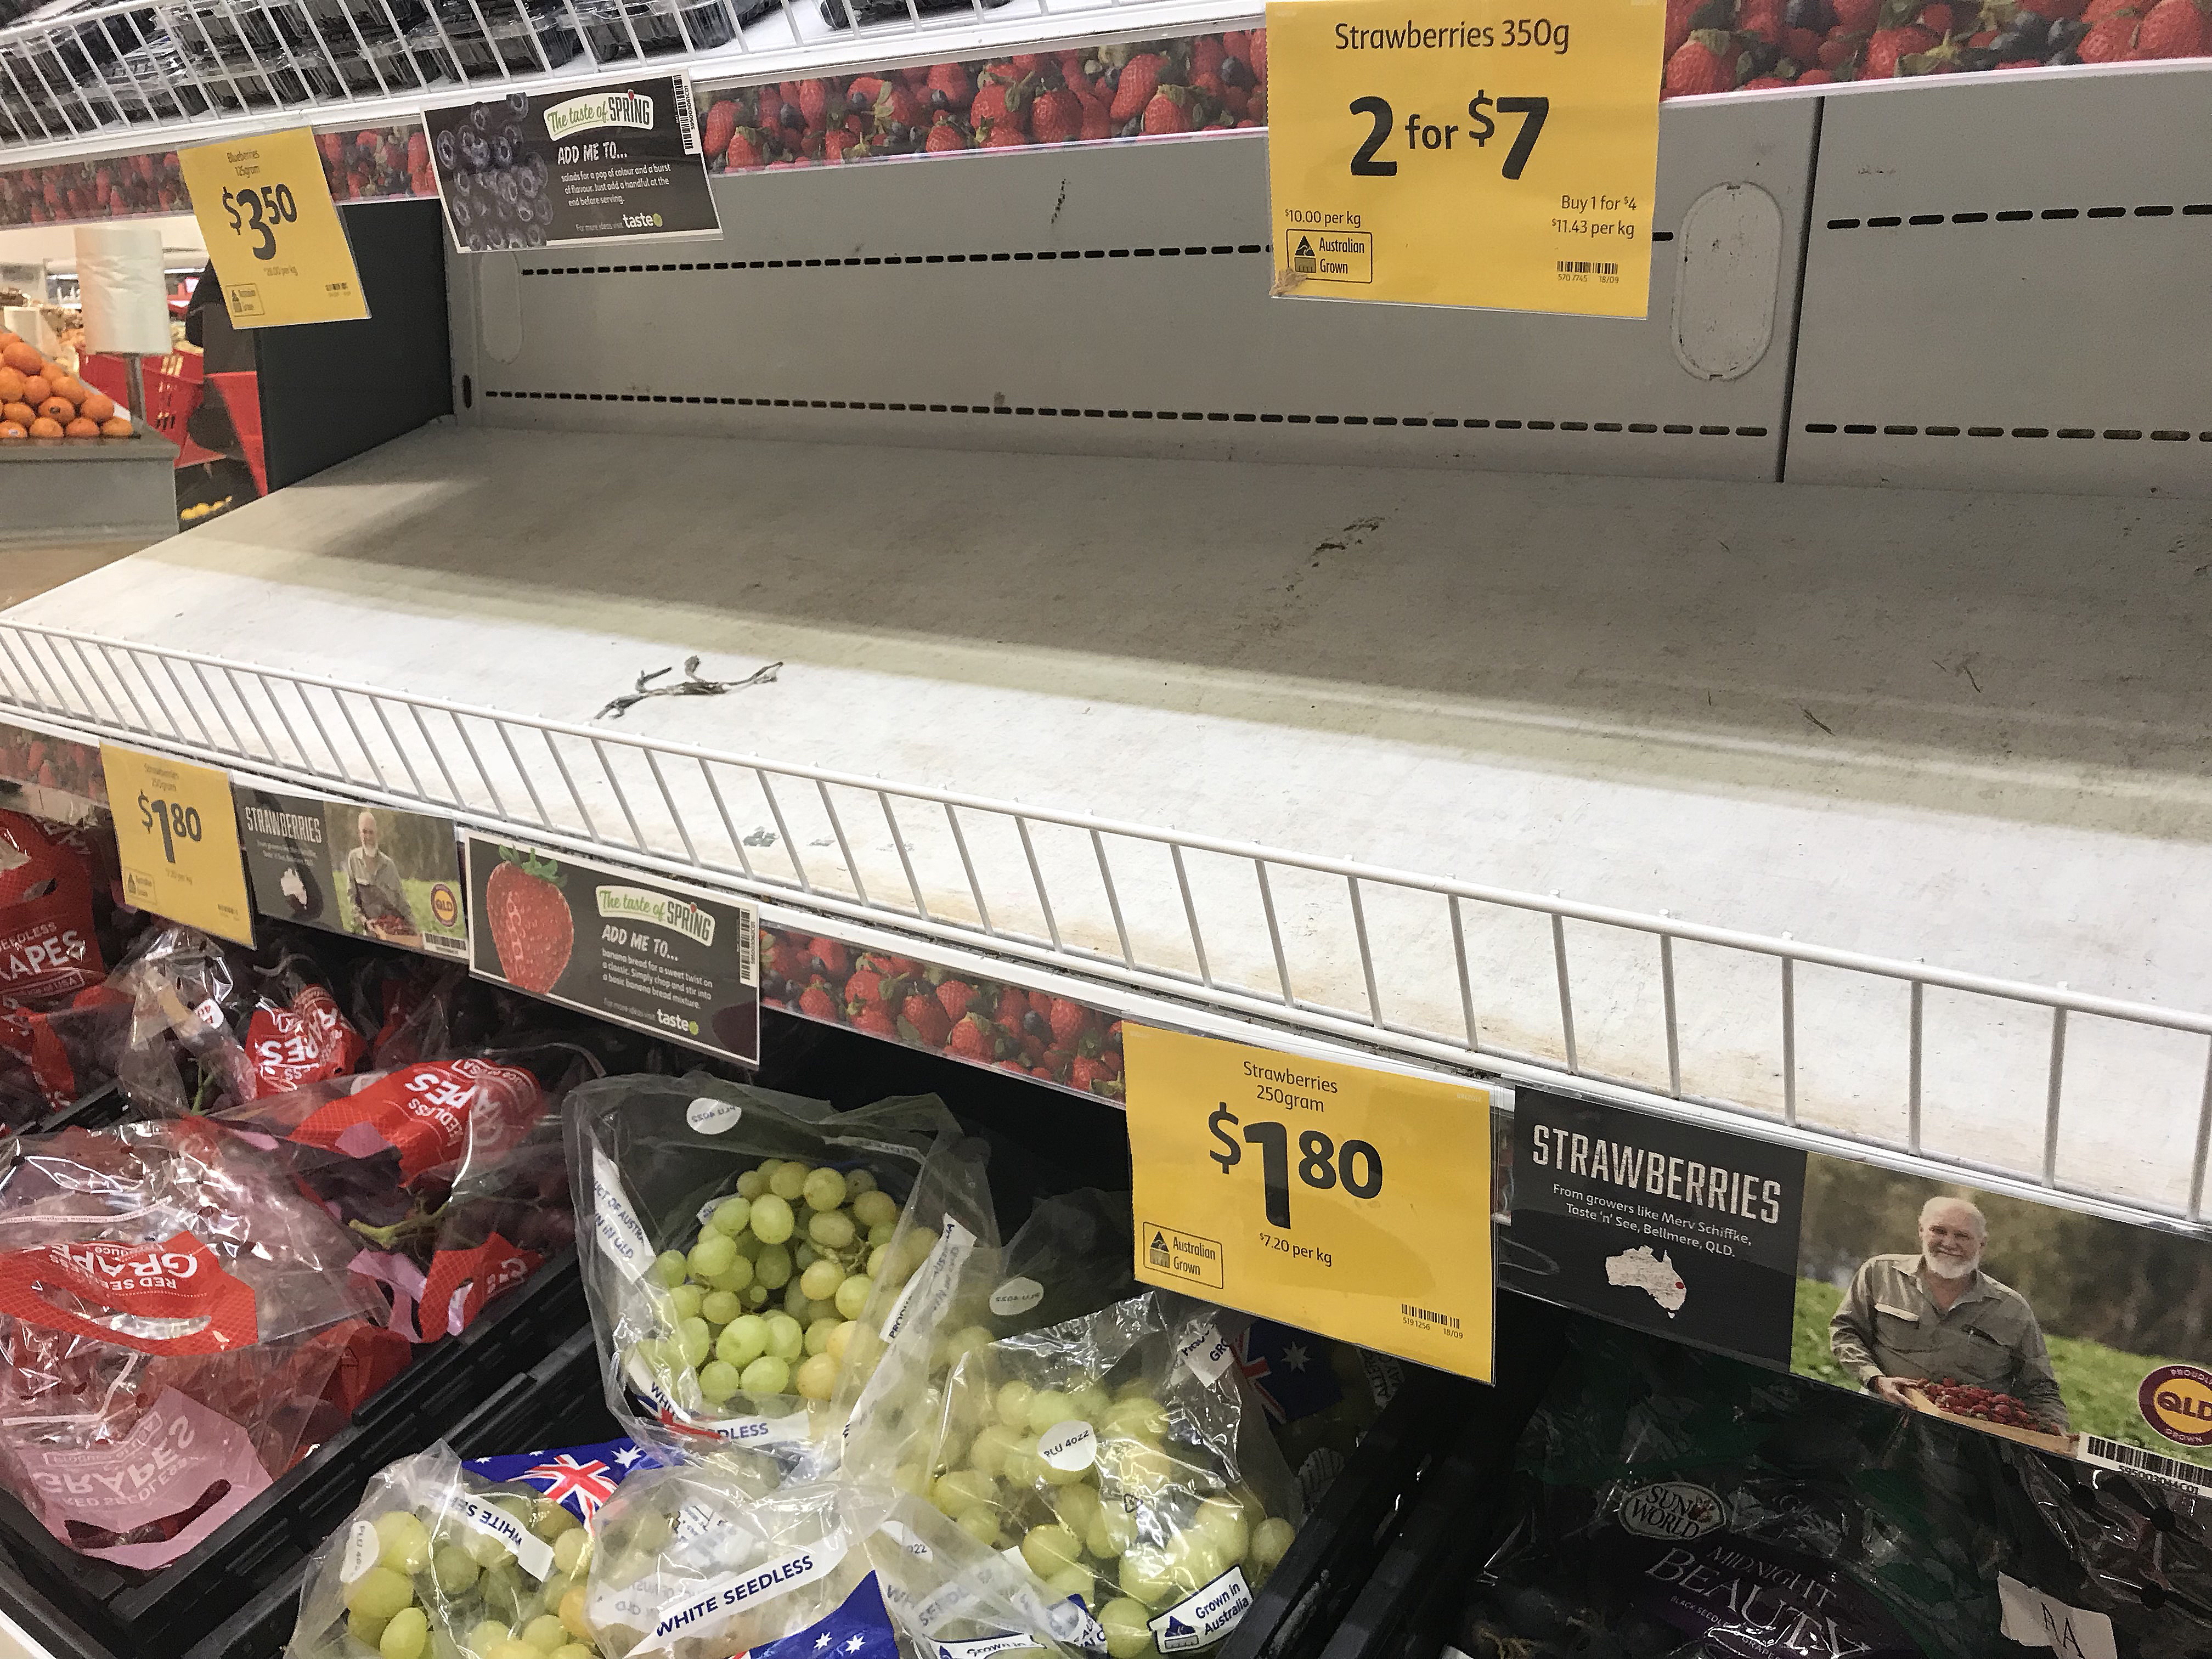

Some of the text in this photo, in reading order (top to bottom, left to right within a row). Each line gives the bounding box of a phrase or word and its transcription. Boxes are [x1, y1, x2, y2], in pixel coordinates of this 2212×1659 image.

[1335, 18, 1570, 55] Strawberries 350g
[548, 110, 567, 133] The
[569, 104, 595, 123] taste
[596, 101, 607, 123] of
[608, 94, 650, 125] SPRING
[1349, 89, 1550, 180] 2 for $7
[558, 141, 627, 165] ADD ME TO...
[561, 172, 580, 182] salads
[580, 171, 589, 180] for
[596, 171, 607, 181] pop
[608, 168, 614, 178] of
[615, 167, 634, 177] colour
[635, 165, 647, 174] and
[653, 163, 671, 173] burst
[607, 181, 619, 190] add
[625, 177, 650, 188] handful
[658, 176, 669, 185] the
[580, 195, 600, 206] before
[1561, 195, 1637, 214] Buy 1 for $4
[622, 213, 654, 228] taste
[1285, 209, 1361, 229] $10.00 per kg
[1551, 218, 1634, 239] $11.43 per kg
[1319, 237, 1364, 253] Australian
[1320, 258, 1348, 274] Grown
[245, 805, 322, 844] STRAWBERRIES
[600, 890, 712, 941] The taste of SPRING
[602, 924, 678, 961] ADD ME TO...
[657, 1008, 689, 1031] taste
[1243, 1061, 1338, 1094] Strawberries
[1256, 1085, 1324, 1113] 250gram
[1533, 1125, 1781, 1224] STRAWBERRIES
[1553, 1183, 1752, 1246] From growers like Merv Schiffke,
[1566, 1203, 1597, 1221] Taste
[1615, 1215, 1640, 1234] See,
[1644, 1223, 1702, 1250] Bellmere,
[1706, 1241, 1735, 1257] QLD.
[1172, 1237, 1216, 1261] Australian
[1259, 1233, 1332, 1267] $7.20 per kg
[1173, 1256, 1201, 1277] Grown
[140, 1277, 177, 1290] RED
[1443, 1328, 1463, 1339] 18/09
[2157, 1392, 2212, 1421] QLD
[1043, 1430, 1089, 1457] PLU 4022
[2165, 1428, 2203, 1443] GROWN
[1646, 1486, 1693, 1516] SUN
[479, 1511, 522, 1545] WHITE
[1633, 1498, 1701, 1537] WORLD
[1707, 1545, 1838, 1607] MIDNIGHT
[657, 1555, 814, 1637] WHITE SEEDLESS
[1195, 1583, 1241, 1619] Grown in
[1646, 1547, 1872, 1659] BEAUTY
[1204, 1597, 1249, 1635] Australia
